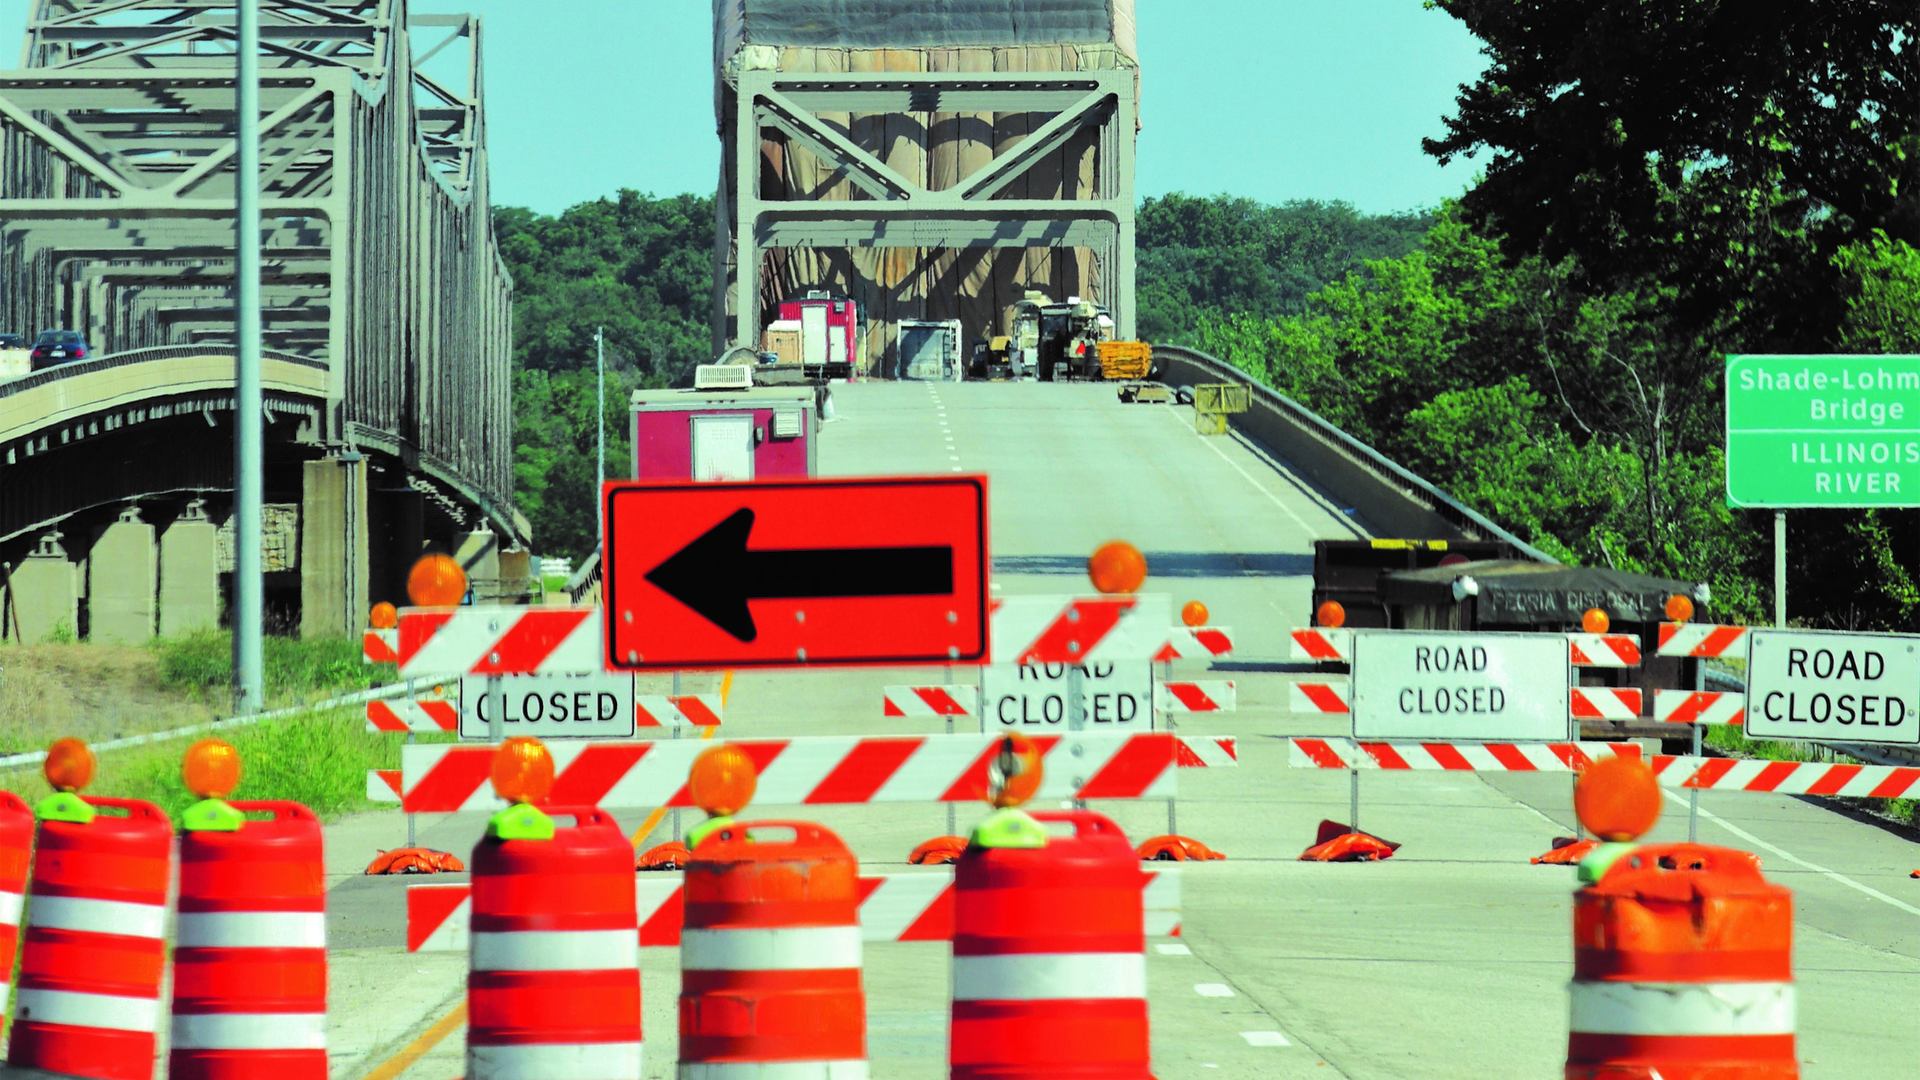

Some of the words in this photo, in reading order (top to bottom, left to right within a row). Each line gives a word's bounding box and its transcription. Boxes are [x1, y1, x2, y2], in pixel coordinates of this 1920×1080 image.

[1810, 397, 1905, 426] Bridge
[1790, 441, 1920, 464] ILLINOIS
[1815, 472, 1901, 493] RIVER
[1492, 592, 1556, 612] PEORIA
[1415, 645, 1487, 672] ROAD
[1787, 648, 1885, 680] ROAD
[996, 693, 1137, 725] CLOED
[1399, 686, 1505, 714] CLOSED
[1763, 690, 1906, 727] CLOSED
